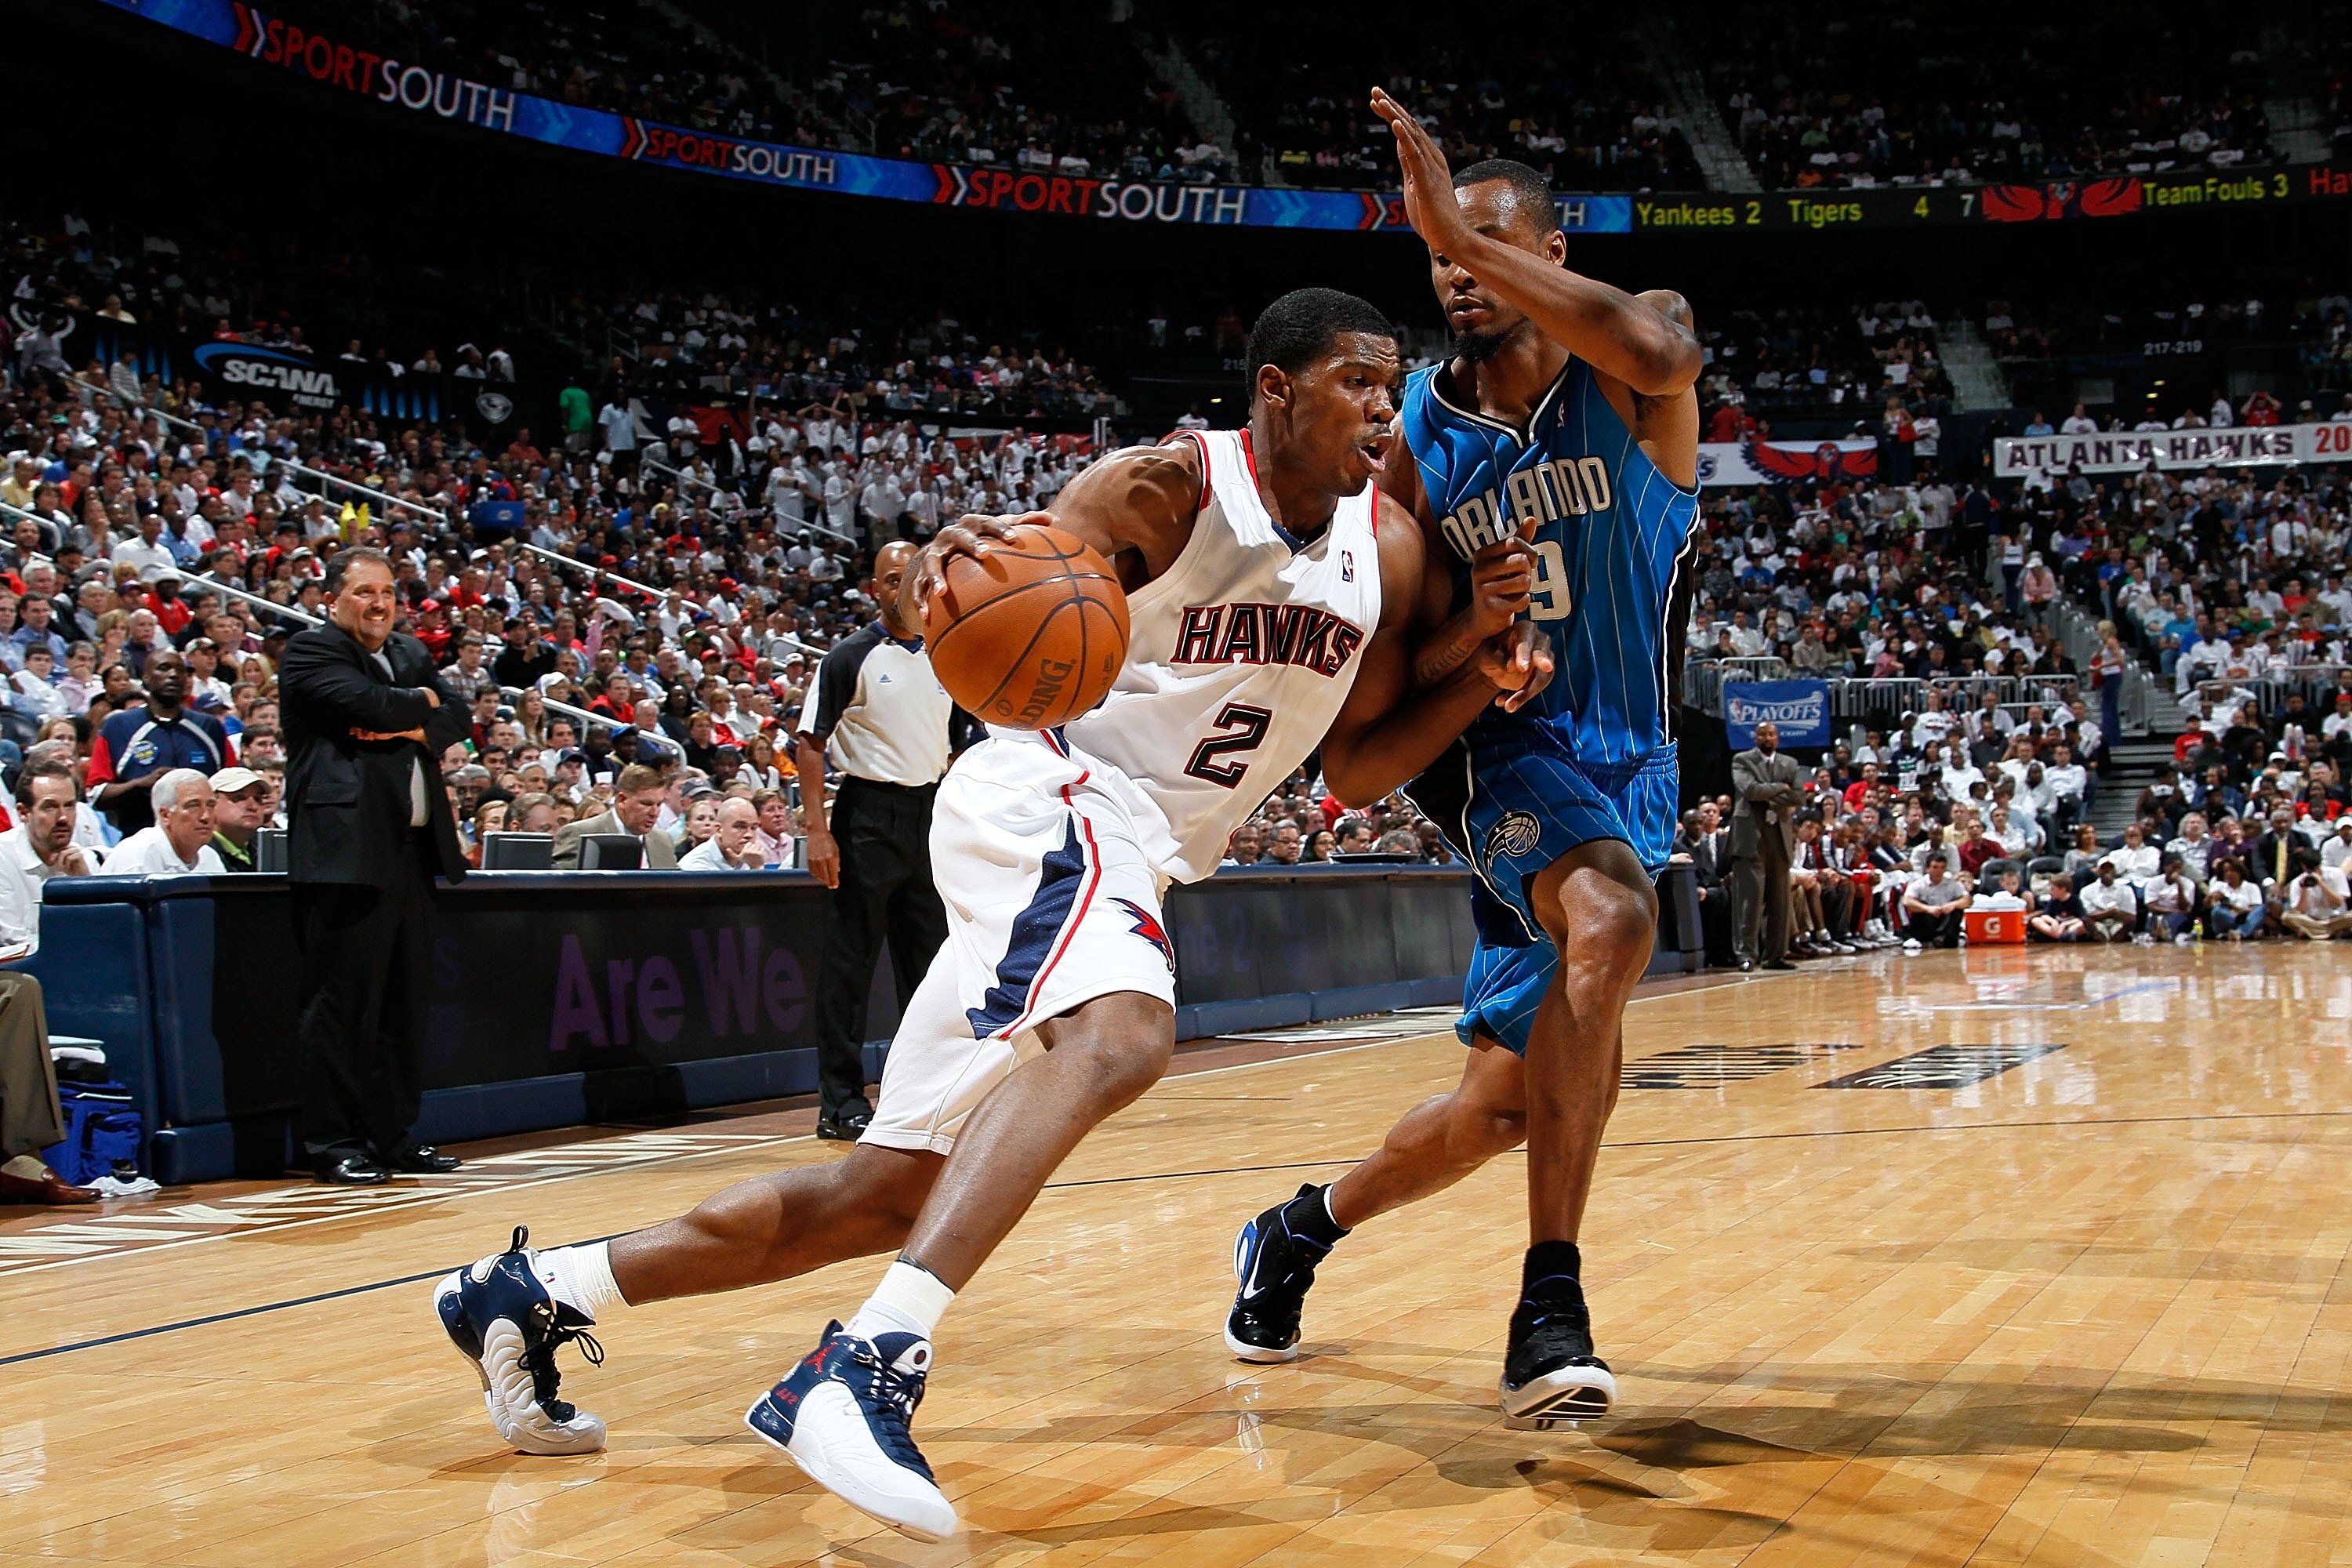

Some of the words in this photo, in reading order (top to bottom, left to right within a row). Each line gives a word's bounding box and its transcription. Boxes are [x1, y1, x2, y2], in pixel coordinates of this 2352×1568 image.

[263, 19, 516, 132] SPORTSOUTH
[646, 129, 835, 184] SPORTSOUTH
[967, 171, 1247, 224] SPORTSOUTH
[2273, 172, 2289, 198] 3
[2309, 167, 2352, 195] Ha
[1636, 201, 1736, 227] Yankees
[1745, 201, 1762, 225] 2
[1787, 199, 1864, 229] Tigers
[1913, 195, 1929, 219] 4
[1961, 194, 1976, 218] 7
[2143, 339, 2203, 356] 217-219
[223, 358, 336, 396] SCANA
[2007, 437, 2154, 468] ATLANTA
[2169, 431, 2294, 462] HAWKS
[1440, 456, 1612, 564] ORLANDO
[1529, 539, 1572, 622] 9
[1170, 602, 1365, 679] HAWKS
[1741, 704, 1822, 722] PLAYOFFS
[1182, 702, 1273, 790] 2
[549, 932, 687, 1054] Are
[688, 926, 808, 1039] We
